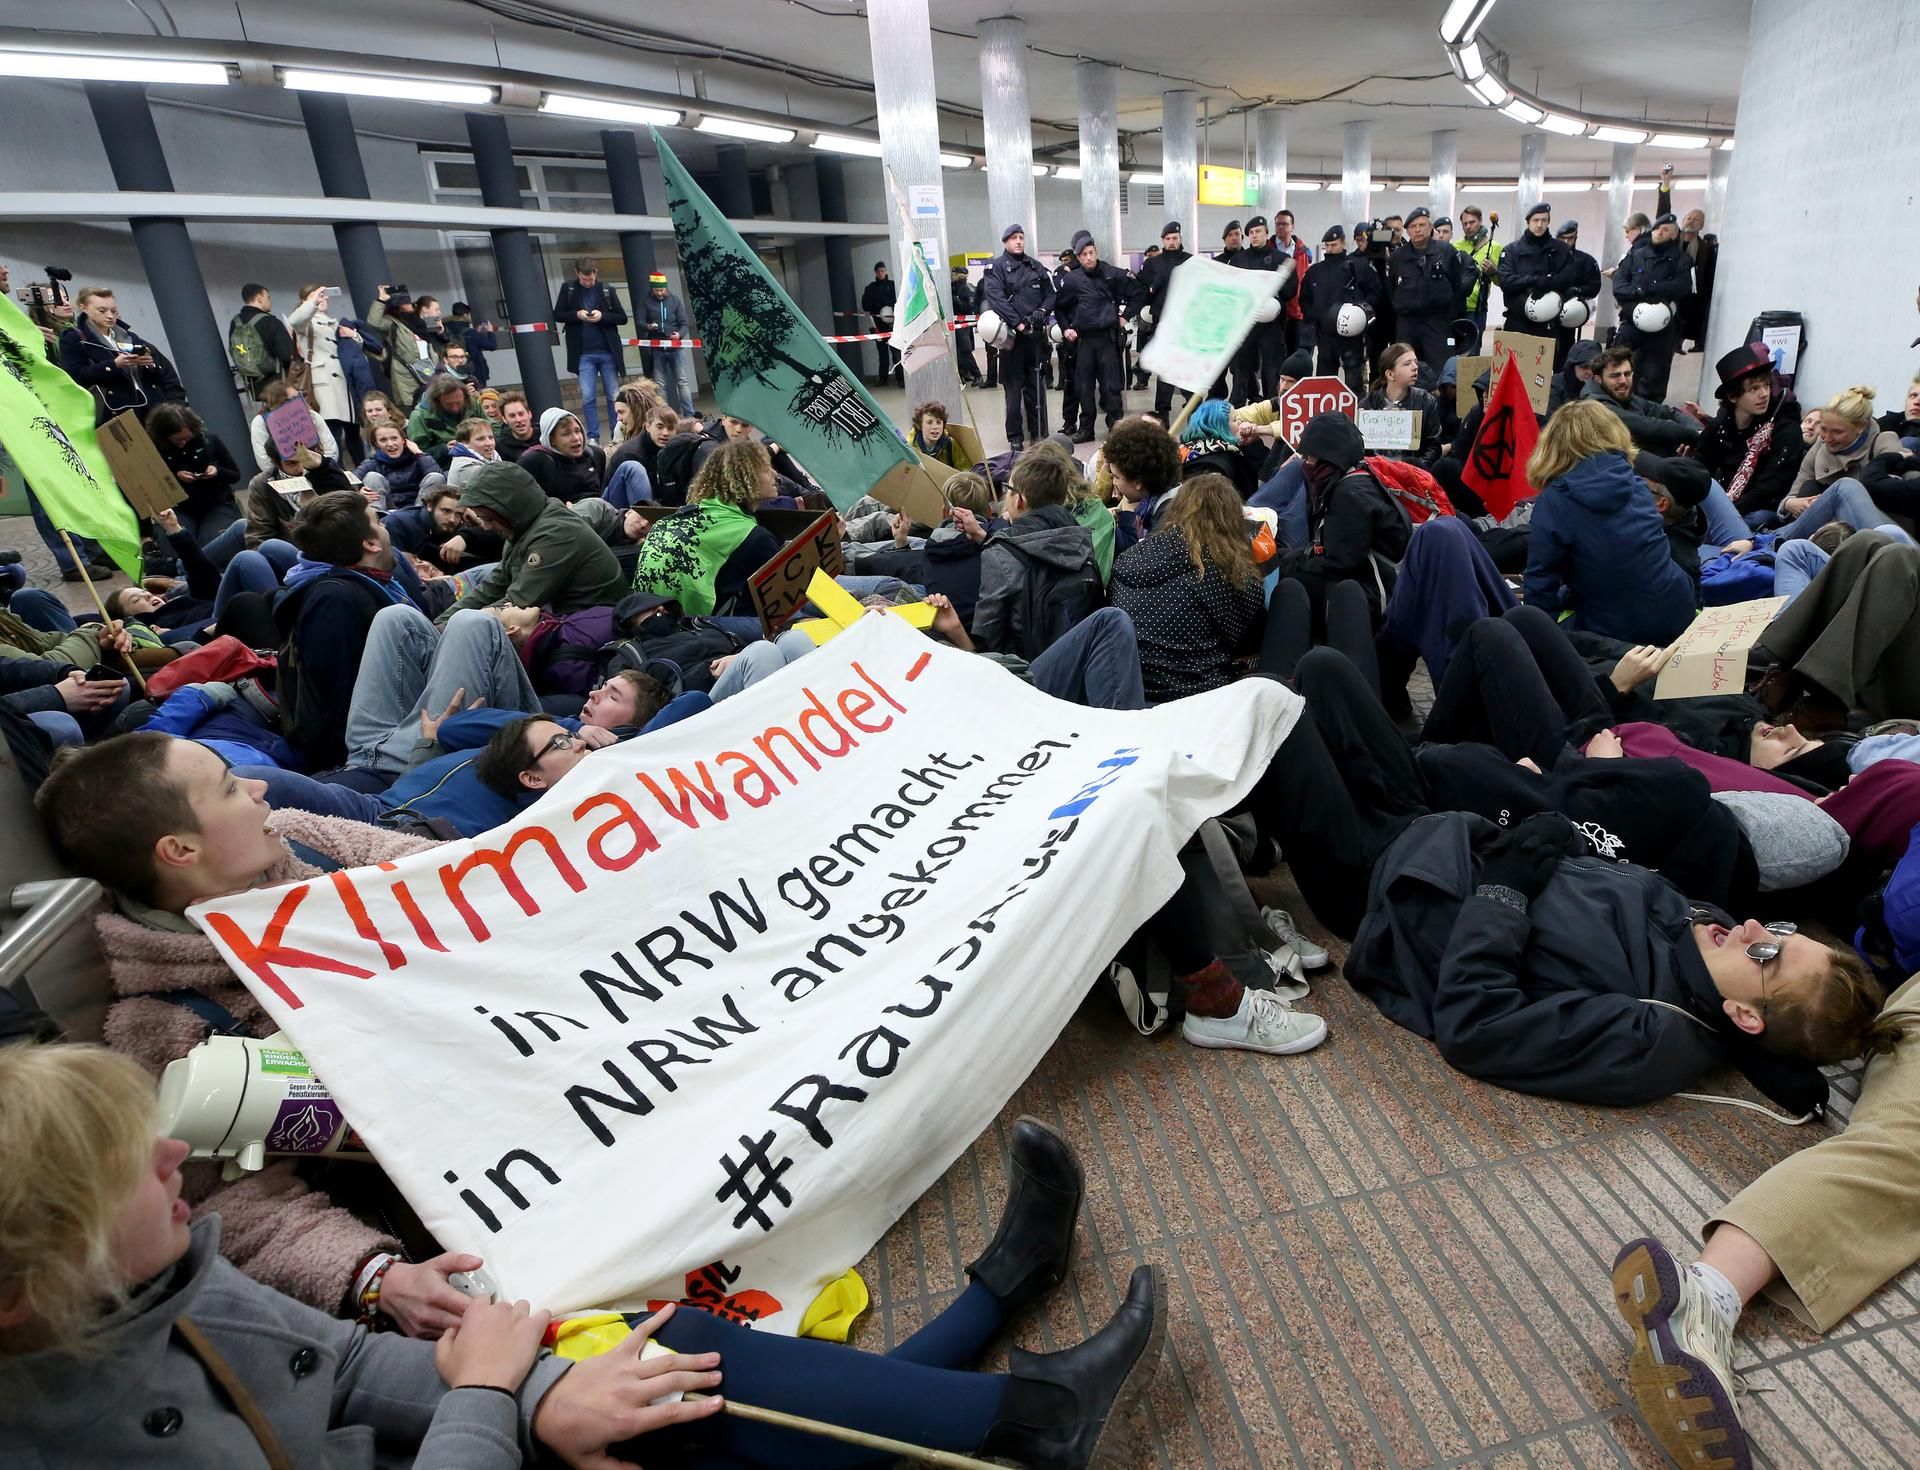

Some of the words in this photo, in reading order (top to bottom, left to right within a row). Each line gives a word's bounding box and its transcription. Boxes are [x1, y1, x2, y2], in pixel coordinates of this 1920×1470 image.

[1286, 391, 1353, 420] STOP
[757, 523, 836, 599] FCK
[205, 662, 907, 1009] Klimawandel
[473, 1006, 589, 1057] in
[580, 878, 768, 1023] NRW
[778, 751, 985, 919] gemacht,
[443, 1149, 562, 1233] in
[564, 993, 760, 1147] NRW
